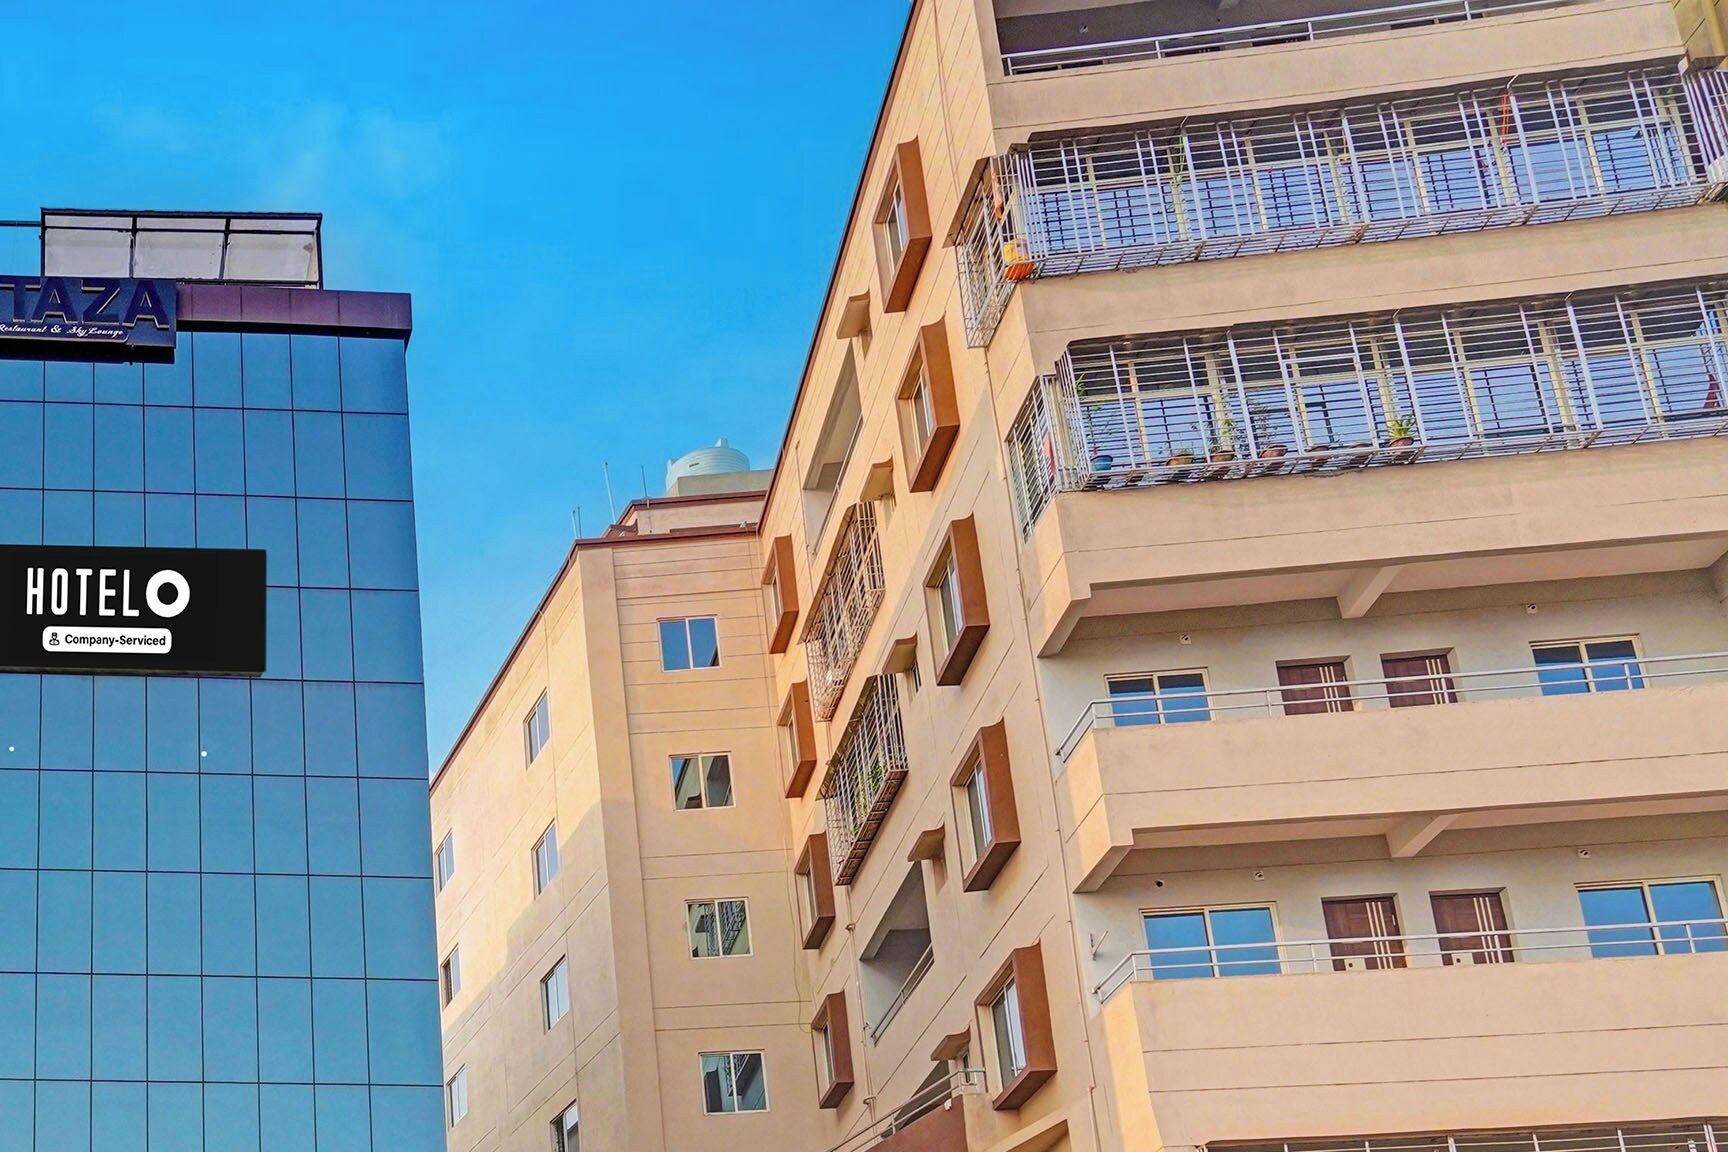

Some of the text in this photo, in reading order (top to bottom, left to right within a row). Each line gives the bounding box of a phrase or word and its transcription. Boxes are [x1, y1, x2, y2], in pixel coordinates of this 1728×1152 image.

[50, 324, 62, 334] &
[26, 567, 140, 617] HOTEL
[64, 633, 167, 648] Company-Serviced
